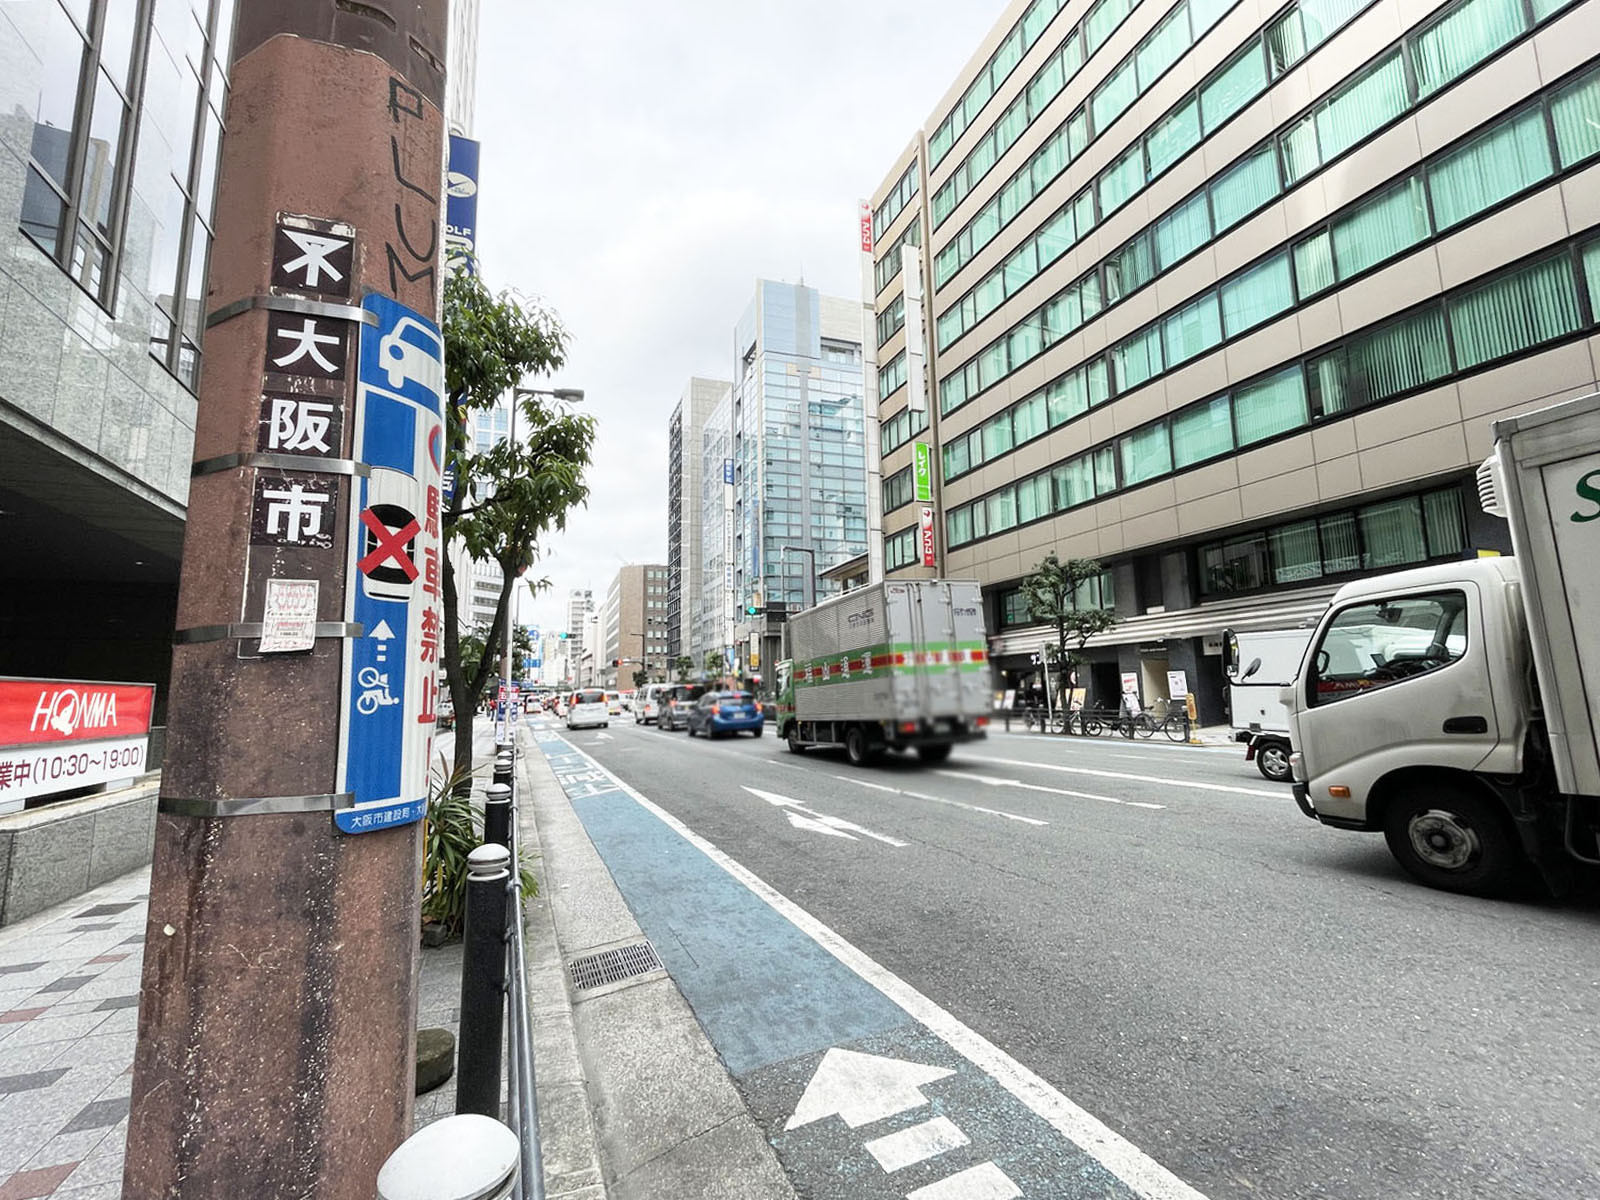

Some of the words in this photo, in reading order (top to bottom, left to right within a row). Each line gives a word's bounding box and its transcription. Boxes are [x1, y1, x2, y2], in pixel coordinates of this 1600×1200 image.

[262, 318, 340, 541] 大阪市
[30, 688, 118, 736] HONMA
